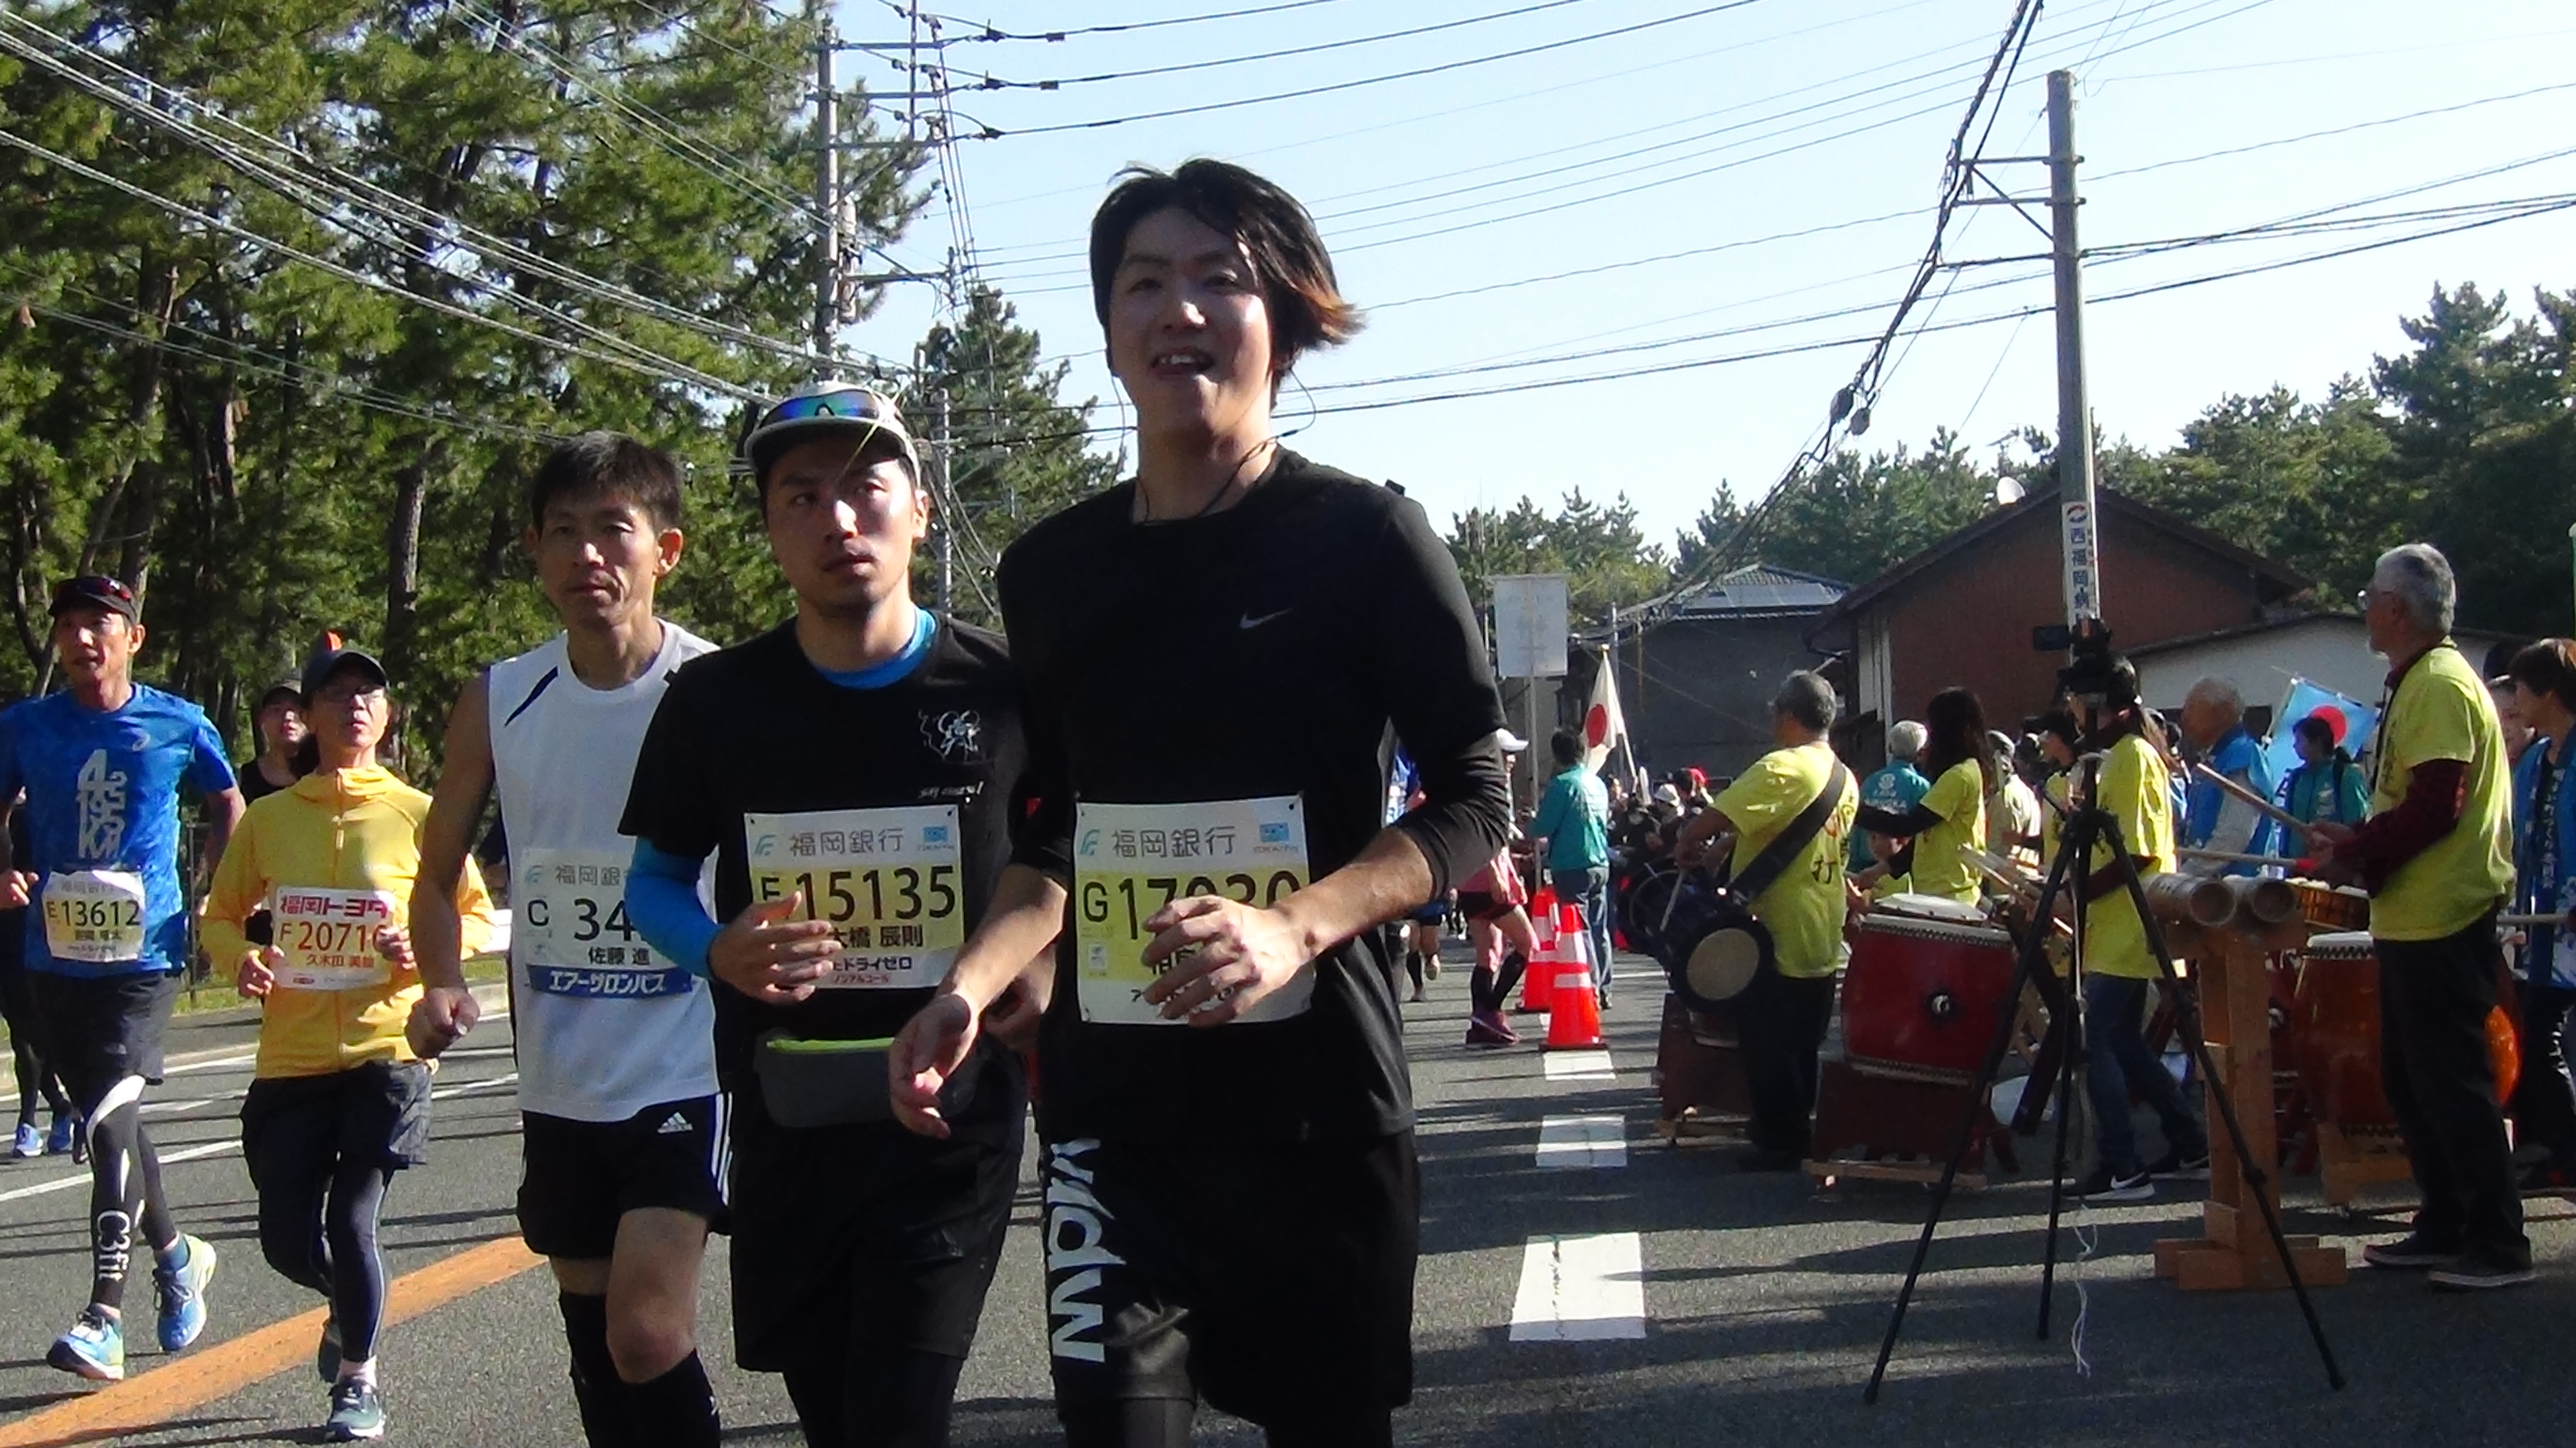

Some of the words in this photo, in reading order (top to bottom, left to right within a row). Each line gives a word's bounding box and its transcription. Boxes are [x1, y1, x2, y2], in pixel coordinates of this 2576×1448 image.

[789, 828, 904, 857] 福岡銀行
[1111, 825, 1236, 858] 福岡銀行
[555, 865, 627, 886] 福岡銀
[280, 895, 388, 918] 福岡トヨタ
[550, 970, 665, 994] エアーサロンパス
[97, 1210, 131, 1281] C3fit
